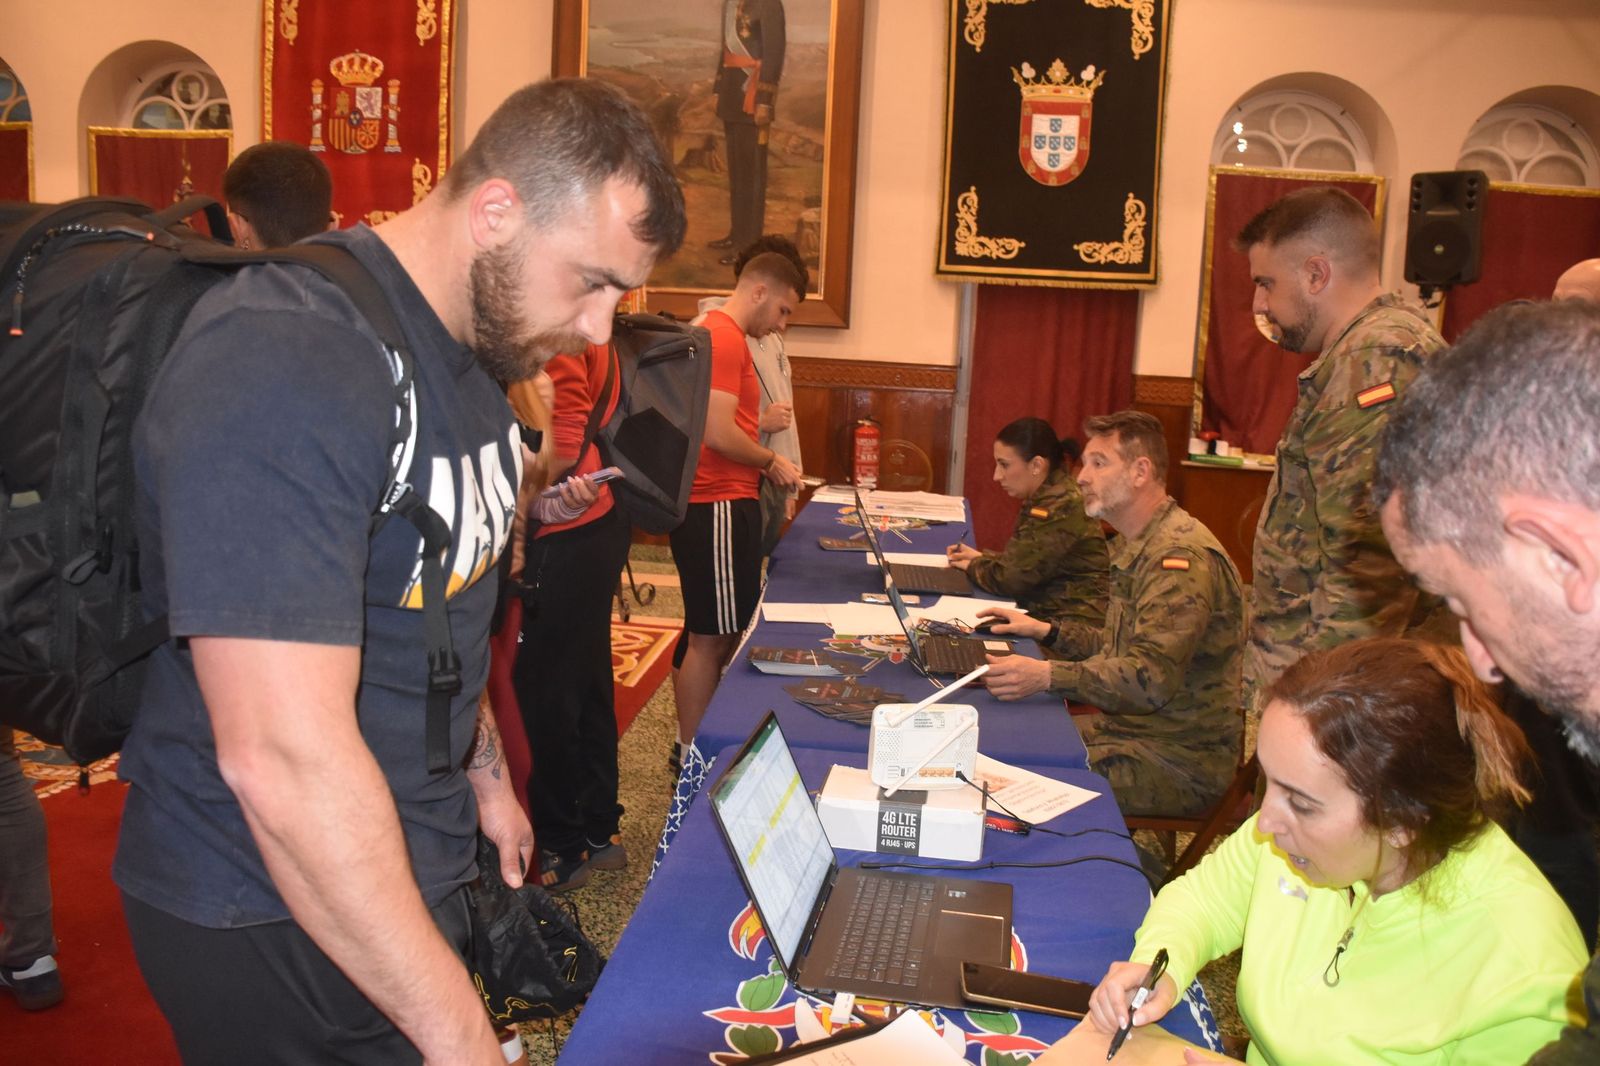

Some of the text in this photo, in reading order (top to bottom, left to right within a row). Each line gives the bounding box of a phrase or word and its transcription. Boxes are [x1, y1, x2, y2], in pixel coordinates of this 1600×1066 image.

[882, 811, 917, 825] 4G LTE
[881, 824, 916, 837] ROUTER
[886, 839, 900, 848] RJ45
[904, 841, 916, 849] UPS
